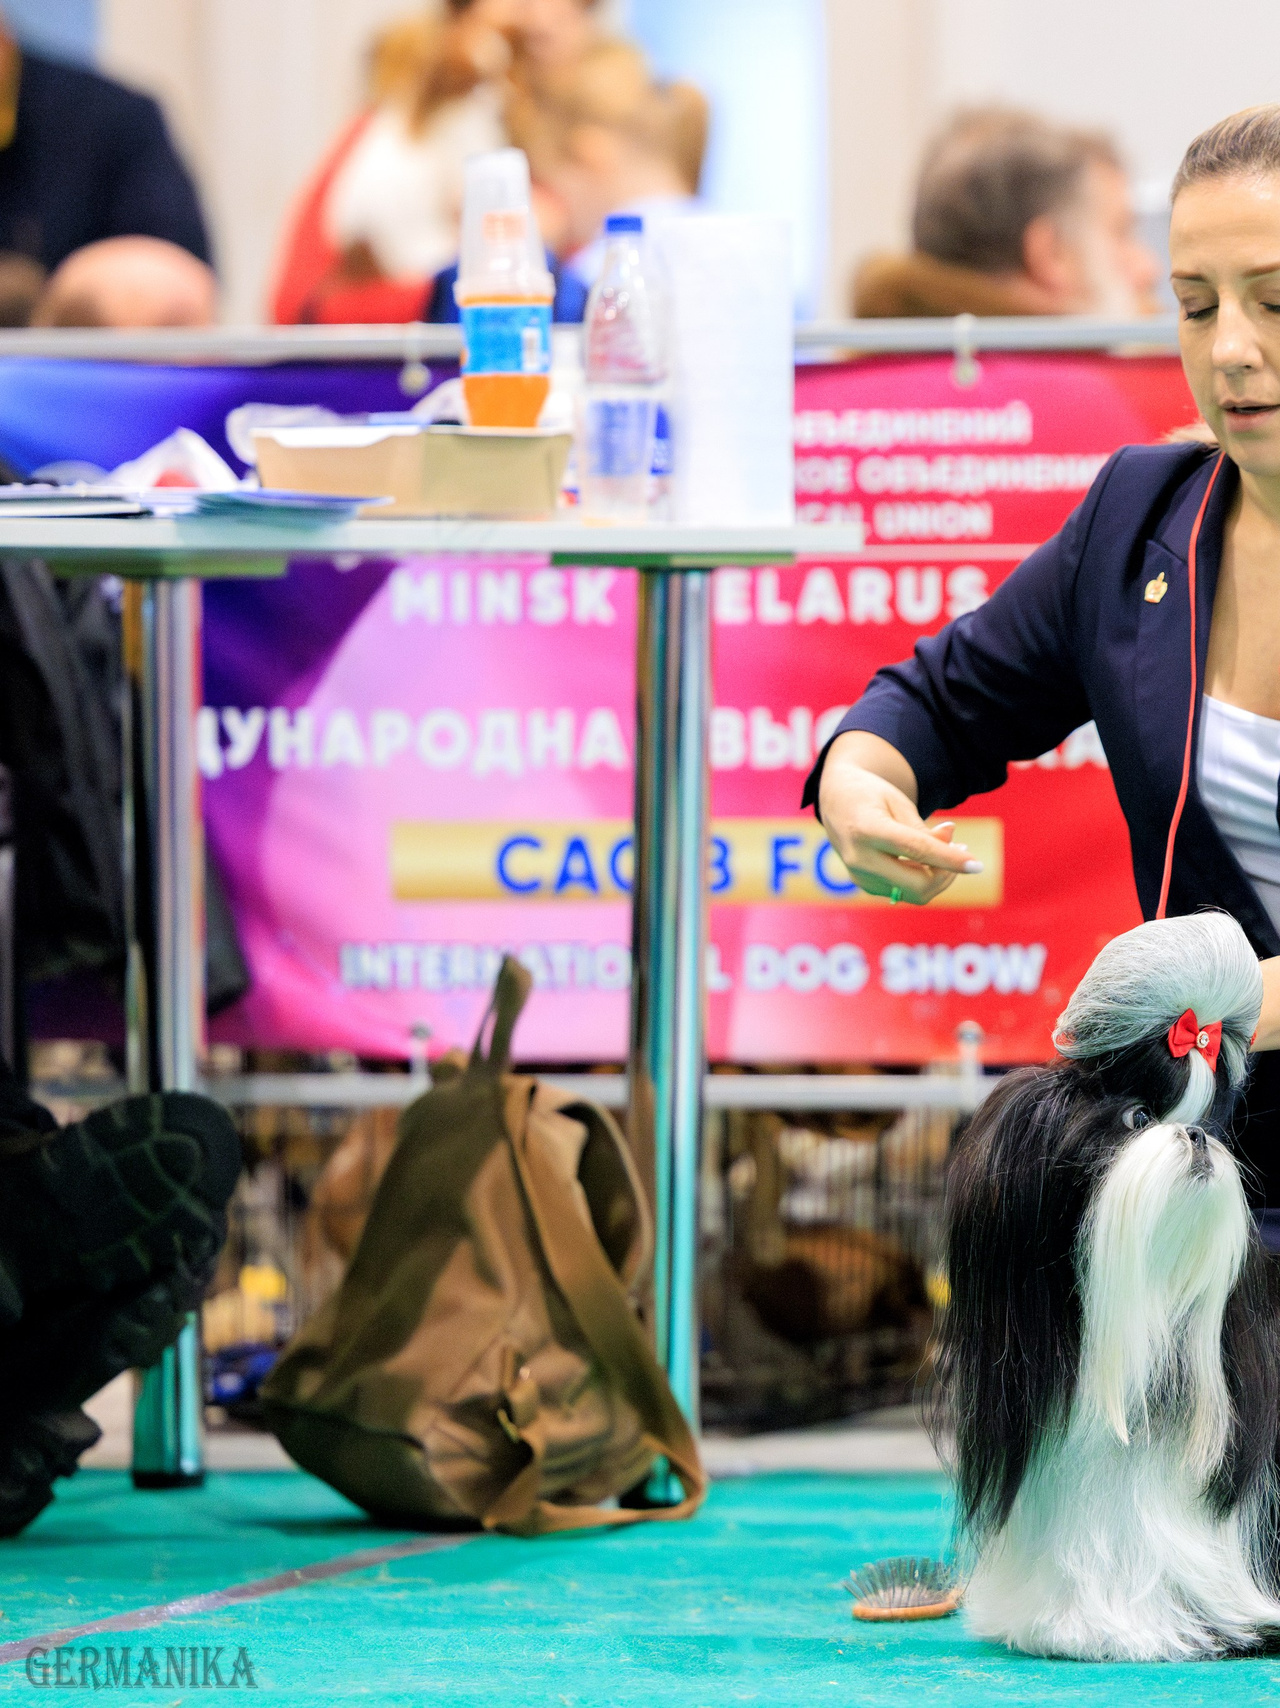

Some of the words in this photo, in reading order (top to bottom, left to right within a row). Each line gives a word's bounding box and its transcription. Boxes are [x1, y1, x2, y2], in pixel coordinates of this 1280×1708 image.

[795, 402, 1033, 449] БЪЕДИНЕНИЙ
[795, 455, 854, 494] ОЕ
[856, 453, 1111, 496] ОБЪЕДИНЕНИ
[872, 502, 994, 540] UNION
[391, 567, 617, 625] MINSK
[714, 567, 990, 625] ELARUS
[745, 943, 869, 994] DOG
[879, 943, 1047, 994] SHOW
